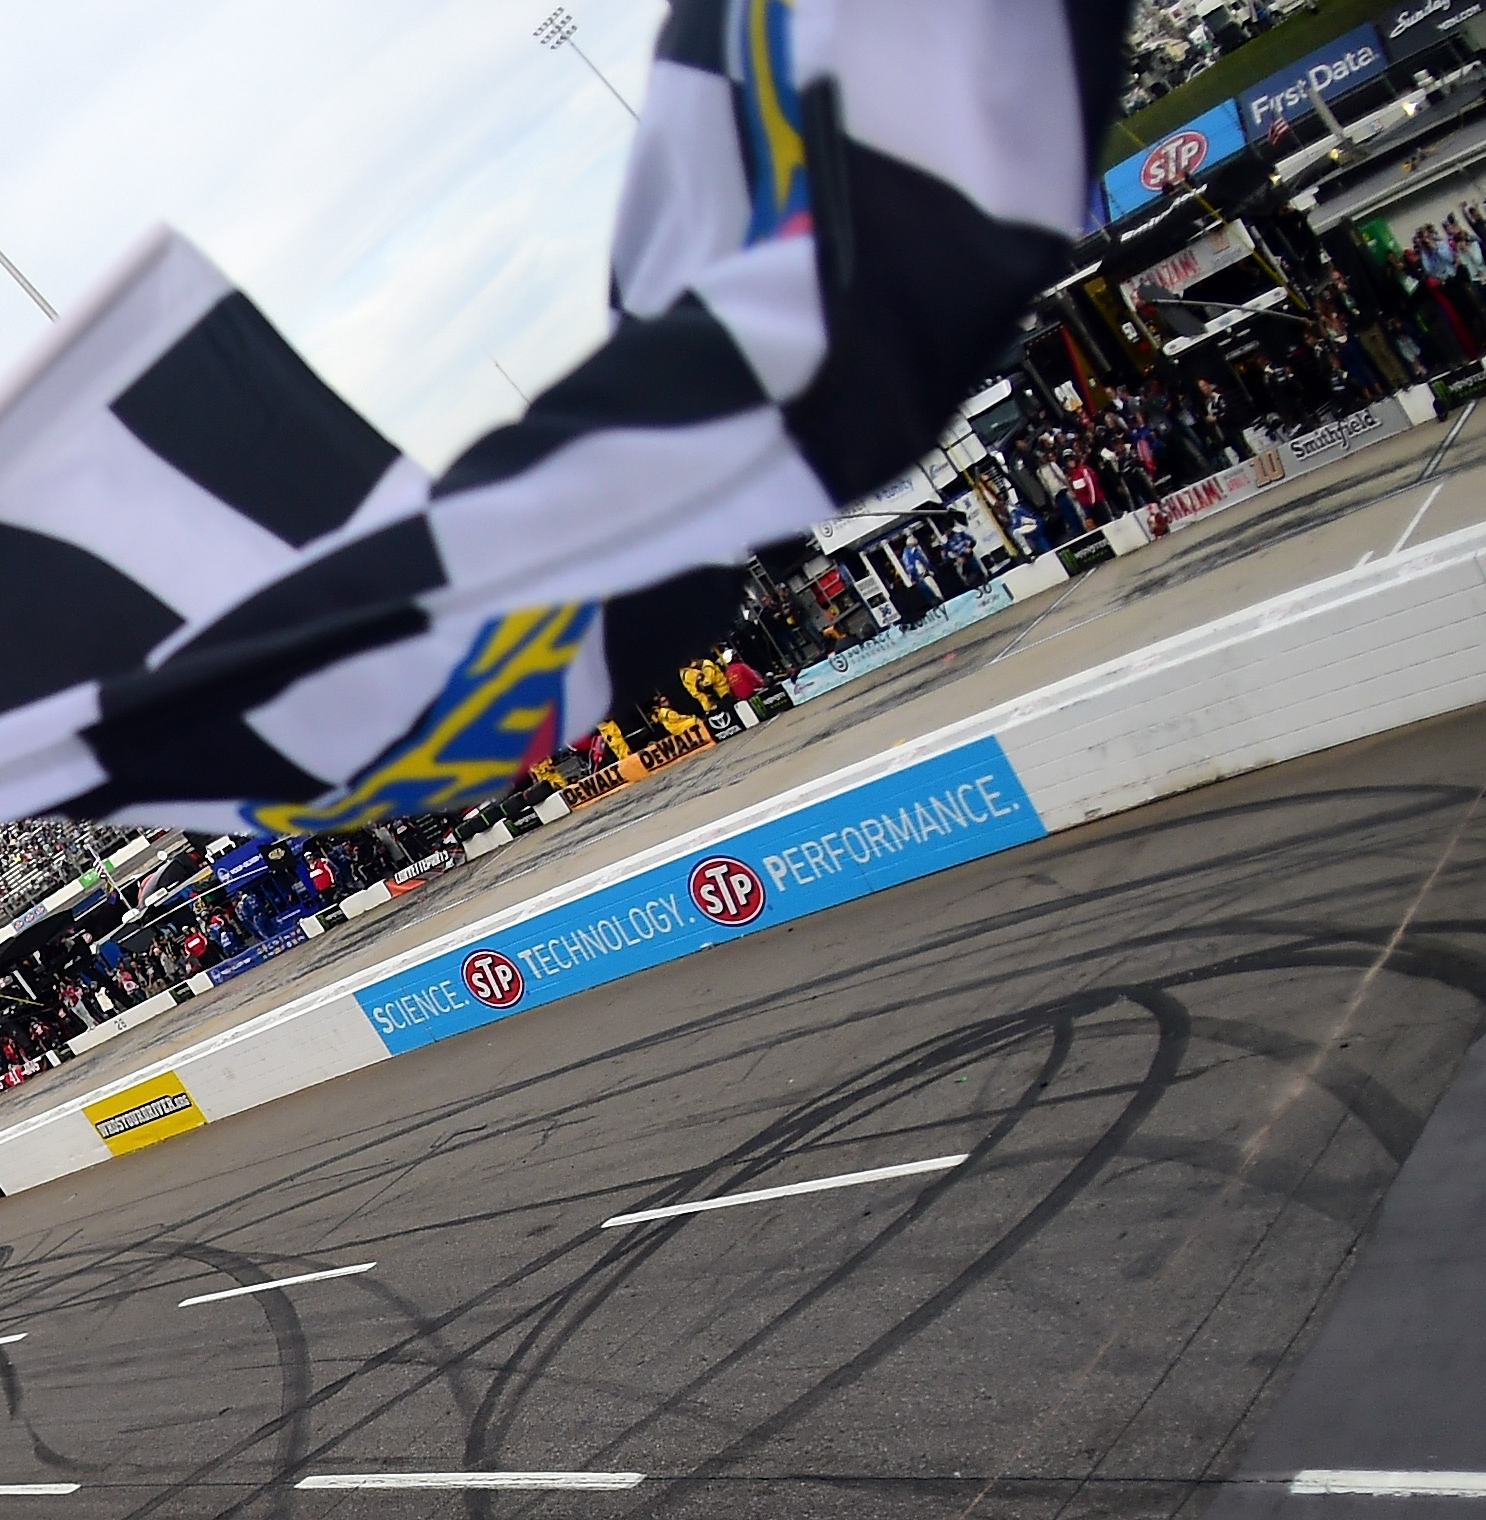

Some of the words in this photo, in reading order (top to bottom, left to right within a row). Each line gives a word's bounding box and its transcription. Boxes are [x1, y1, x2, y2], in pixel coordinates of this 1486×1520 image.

[1149, 136, 1199, 184] STP
[1289, 408, 1377, 459] Smithfield
[1250, 449, 1286, 488] 10
[715, 724, 742, 741] TOYOTA
[761, 774, 1022, 894] PERFORMANCE.
[699, 863, 757, 919] STP
[518, 892, 695, 979] TECHNOLOGY.
[471, 956, 514, 1001] STP
[371, 977, 471, 1035] SCIENCE.
